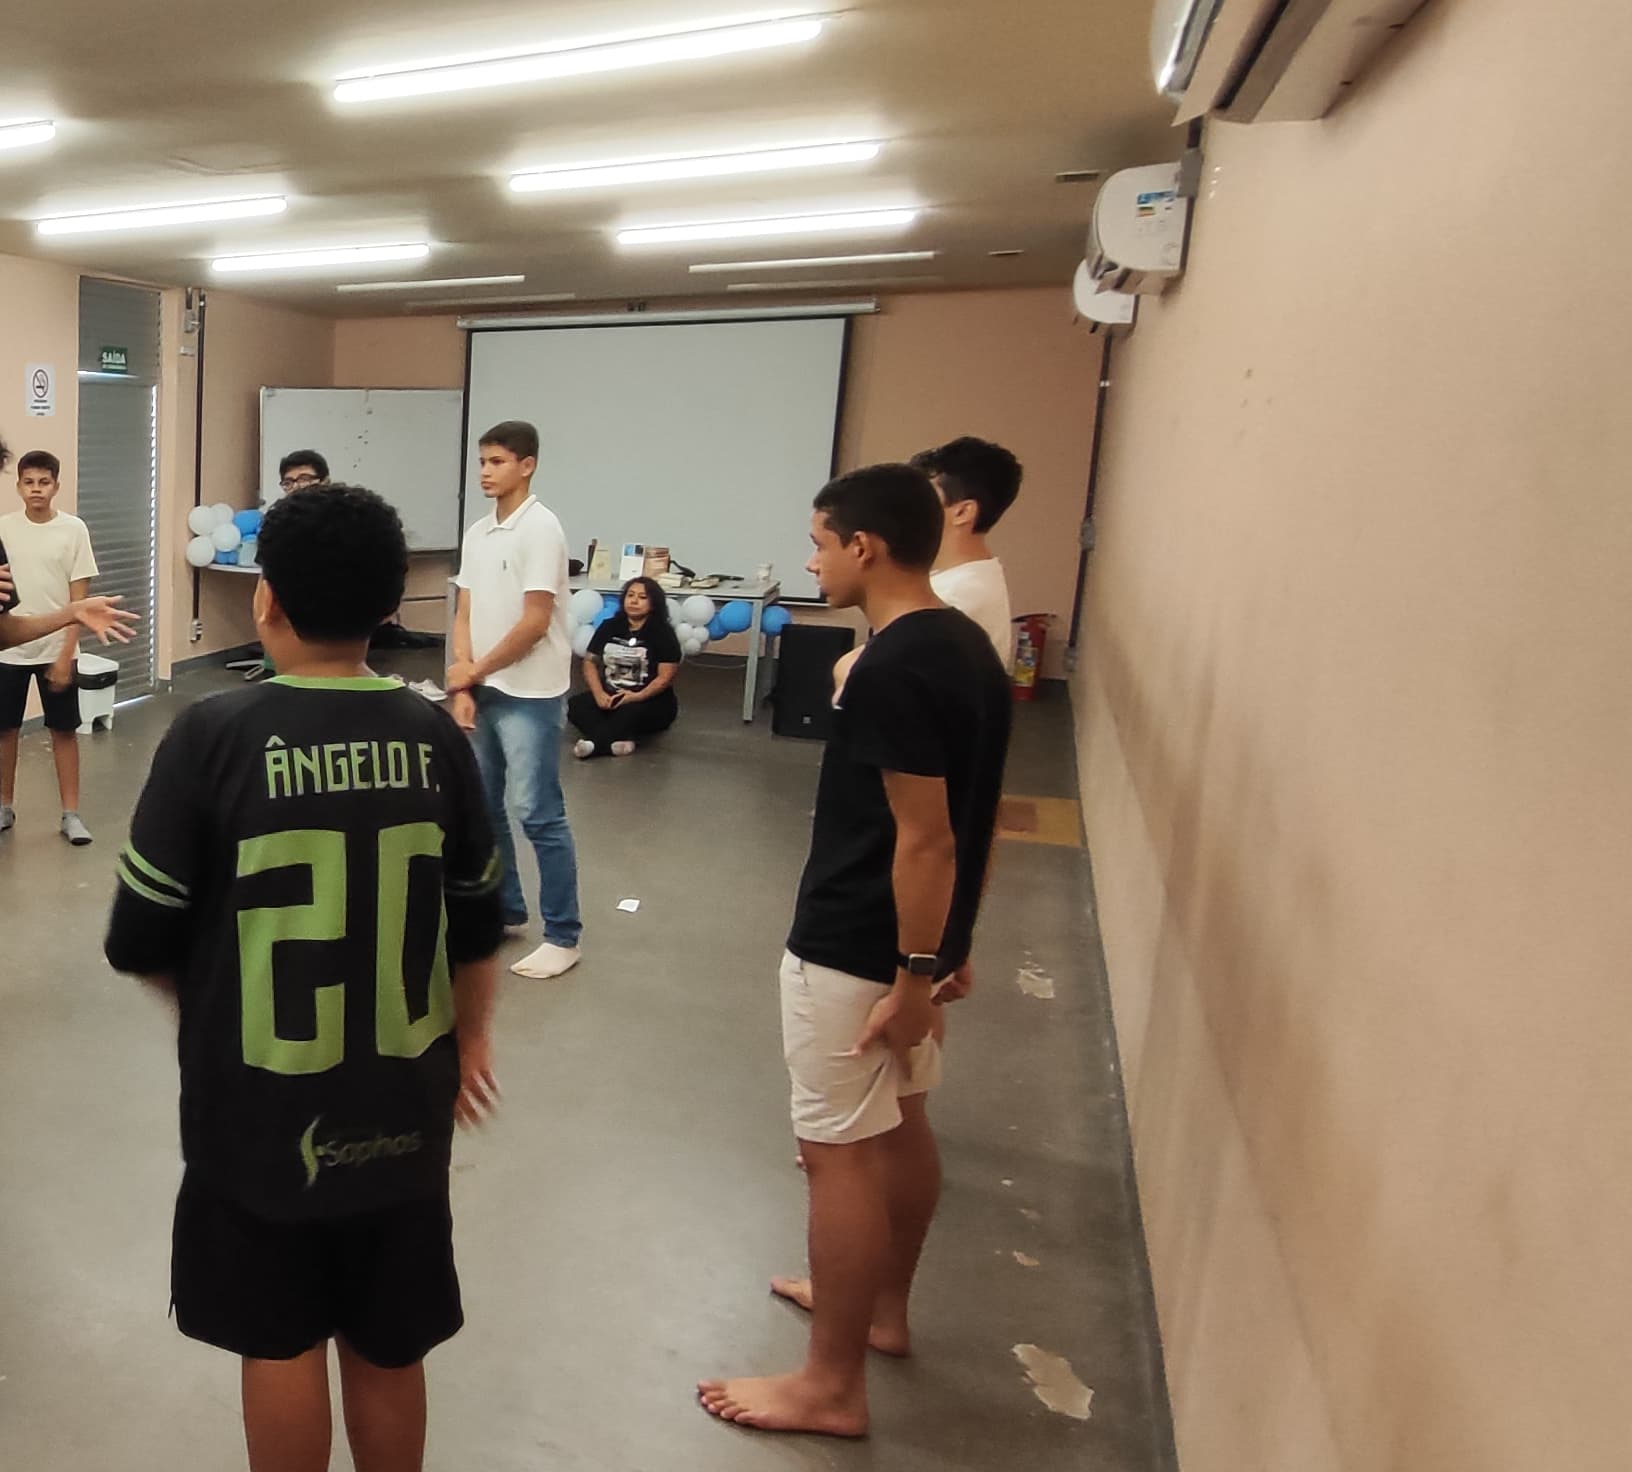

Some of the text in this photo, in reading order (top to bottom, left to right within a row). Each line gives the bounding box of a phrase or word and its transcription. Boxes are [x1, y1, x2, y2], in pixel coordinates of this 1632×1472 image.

[102, 349, 127, 364] SAÍDA
[264, 735, 441, 799] ÂNGELO F.
[236, 821, 456, 1075] 20
